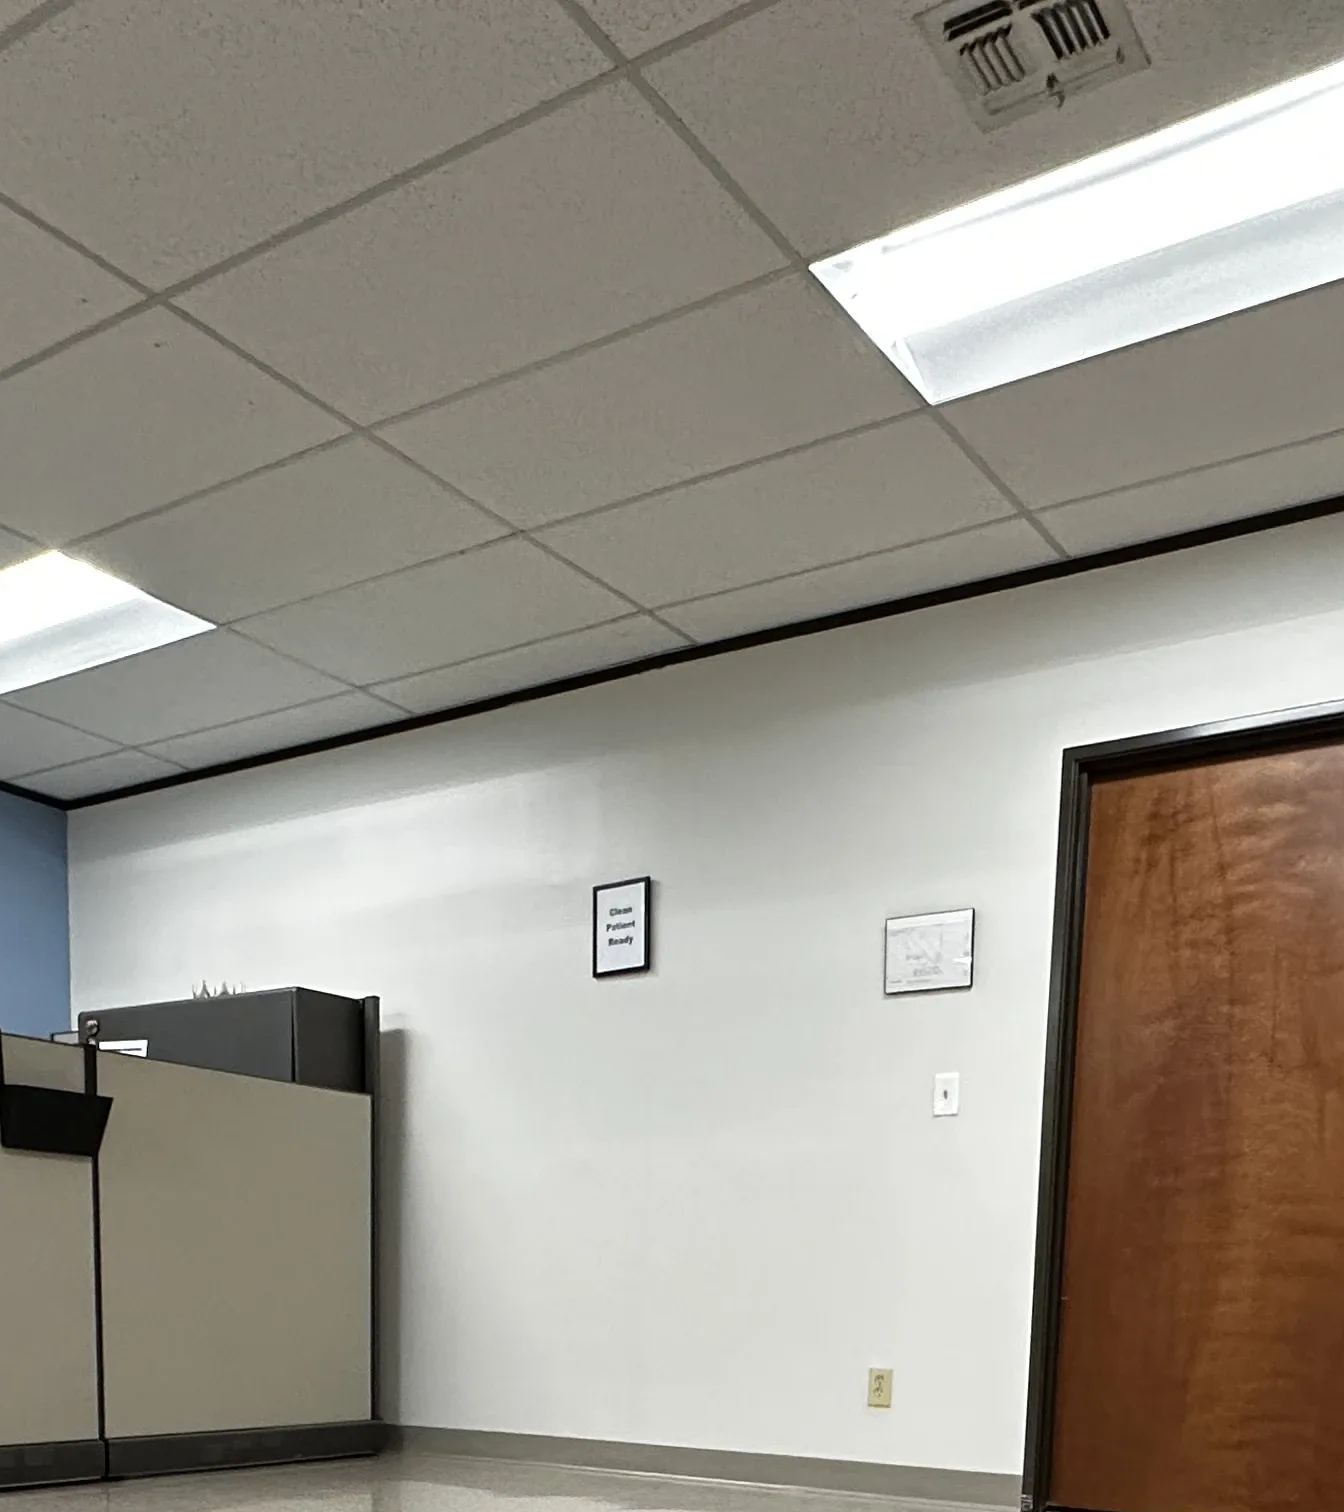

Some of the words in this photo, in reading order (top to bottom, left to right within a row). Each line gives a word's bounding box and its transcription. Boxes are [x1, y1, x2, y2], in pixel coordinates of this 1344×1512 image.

[609, 907, 632, 916] Clean
[606, 920, 635, 932] Patient
[608, 935, 633, 946] Ready
